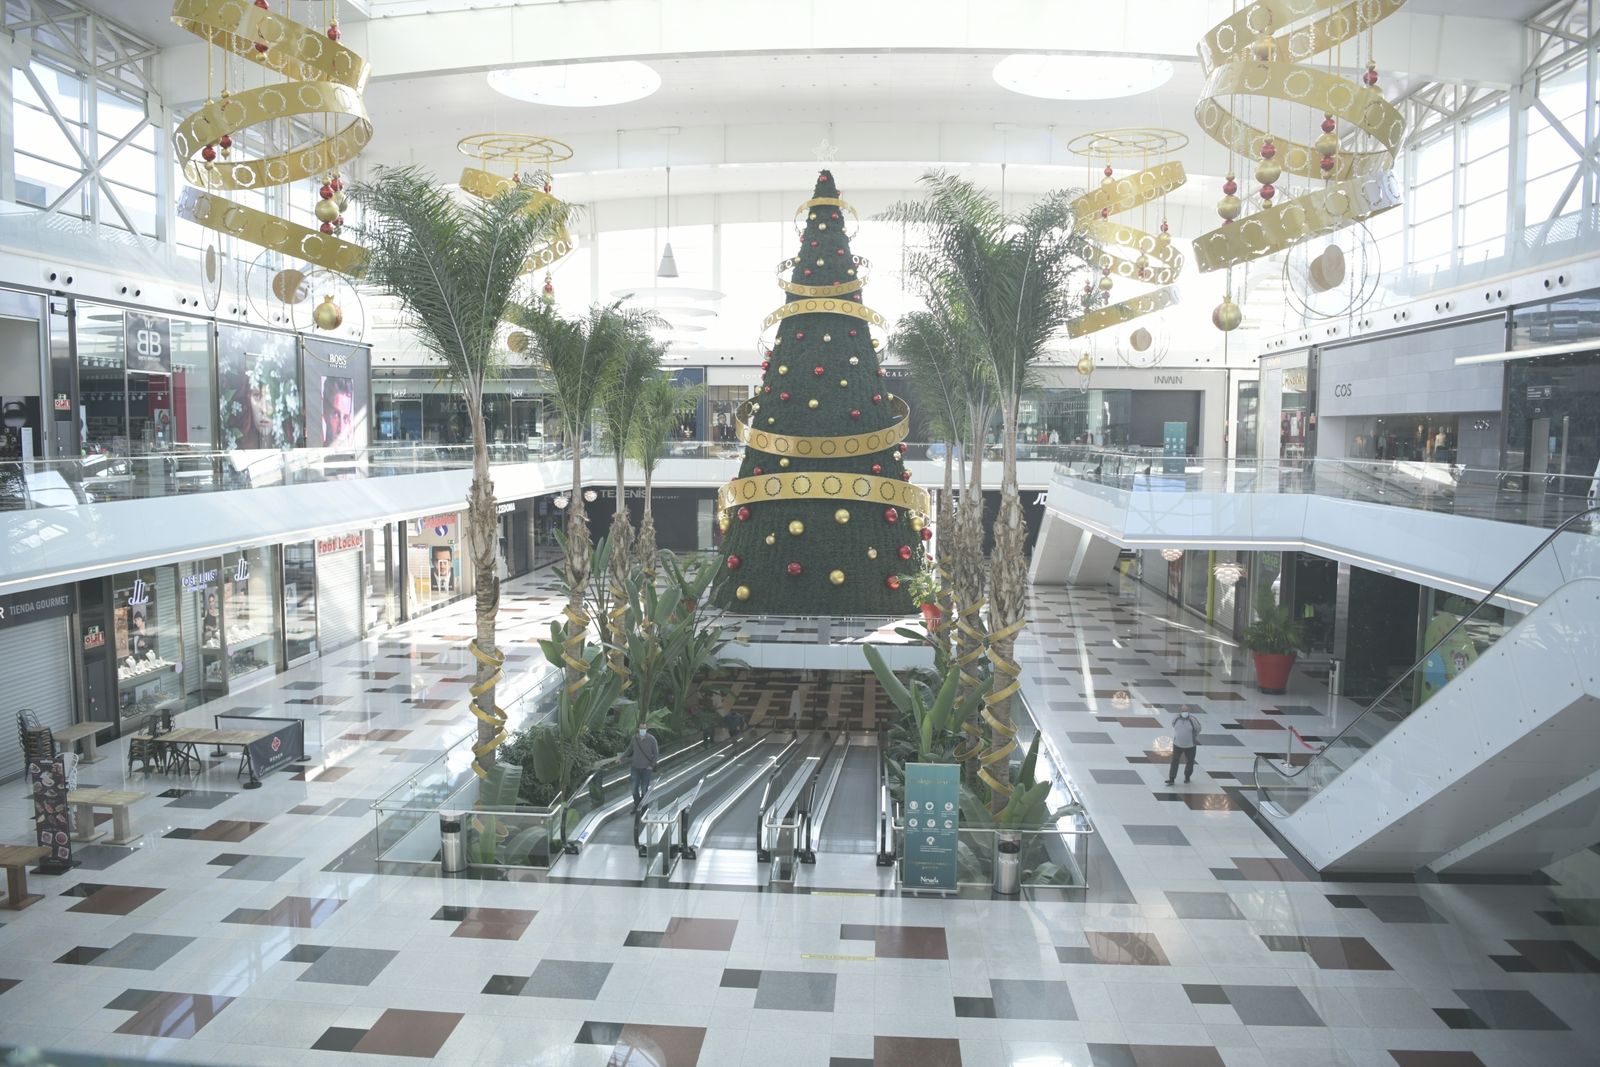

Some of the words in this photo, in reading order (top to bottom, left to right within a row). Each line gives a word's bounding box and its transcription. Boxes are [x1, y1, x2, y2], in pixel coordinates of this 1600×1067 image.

[329, 353, 347, 366] BOSS
[1334, 383, 1352, 398] COS
[599, 487, 649, 498] TEENIS
[9, 602, 35, 616] TIENDA
[35, 595, 69, 610] GOURMET
